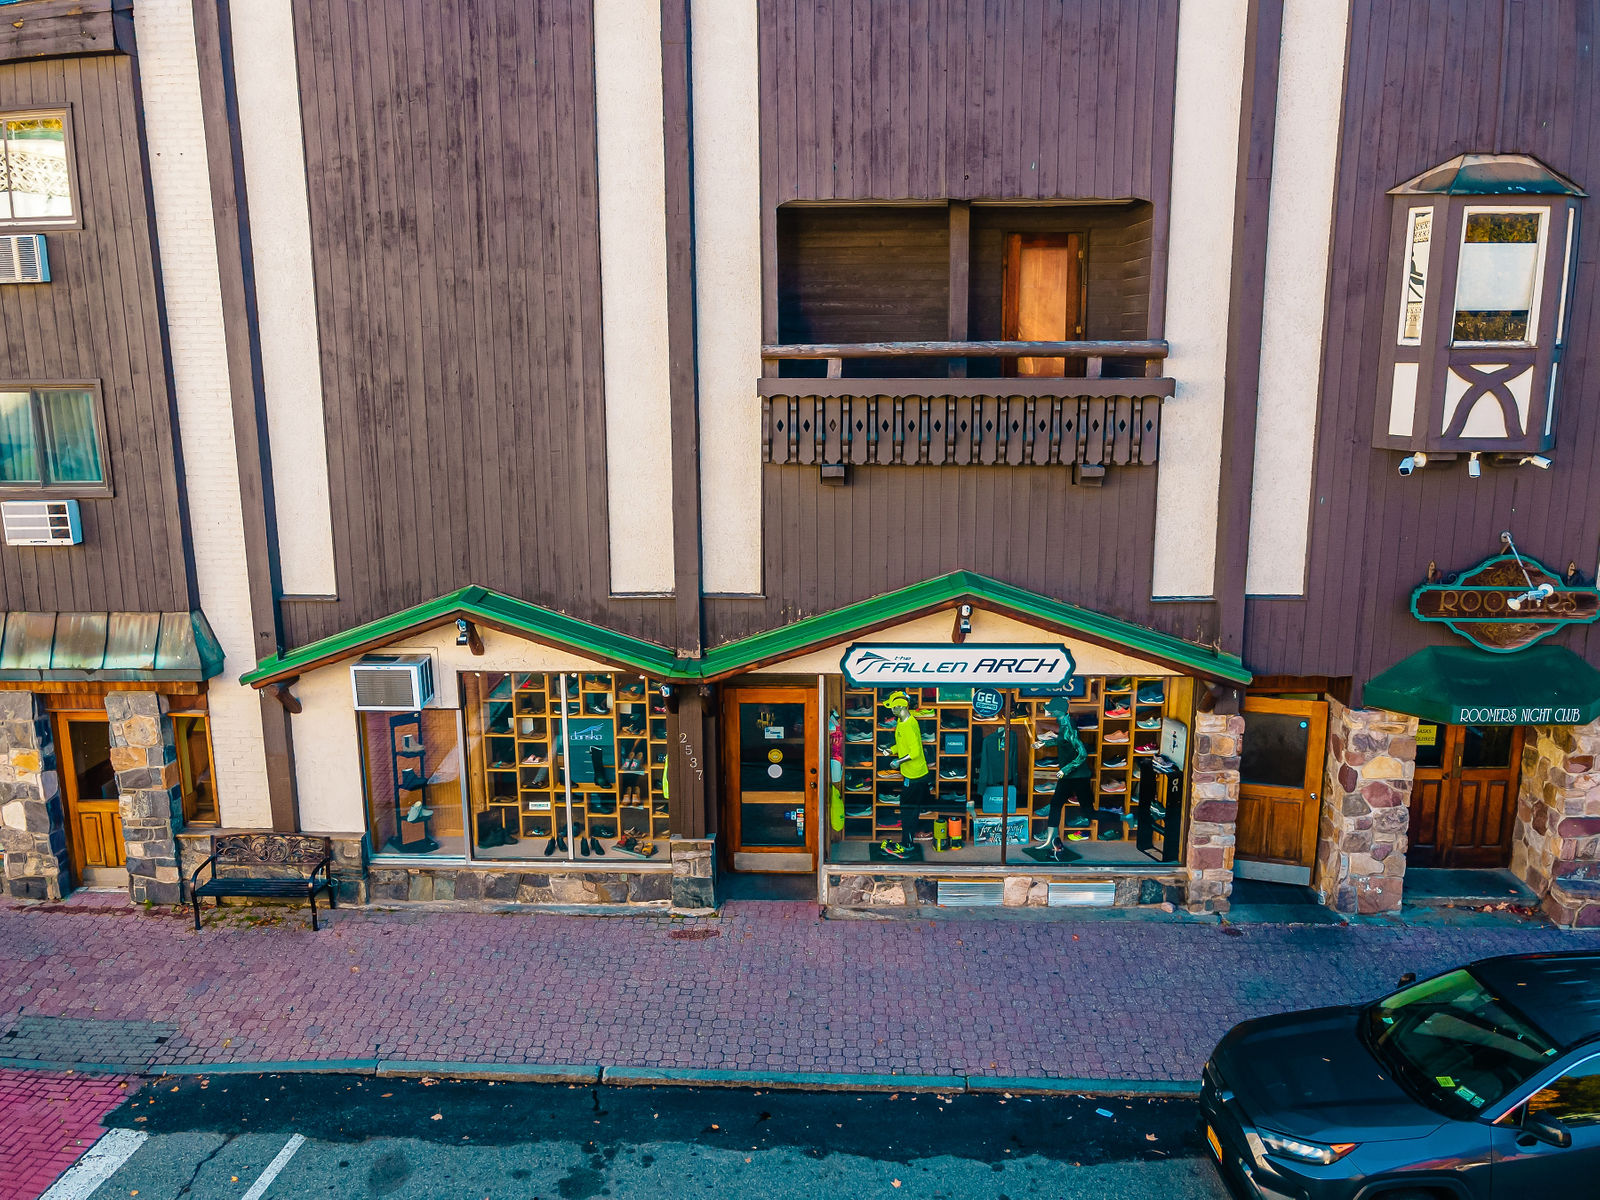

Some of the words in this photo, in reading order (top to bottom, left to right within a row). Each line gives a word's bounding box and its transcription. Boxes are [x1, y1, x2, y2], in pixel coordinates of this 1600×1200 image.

[1438, 590, 1577, 613] ROORS
[877, 661, 969, 673] FALLEN
[972, 658, 1060, 673] ARCH
[977, 691, 999, 705] GEL
[1460, 708, 1517, 723] ROOMERS
[1520, 708, 1552, 722] NIGHT
[1554, 708, 1581, 722] CLUB
[679, 732, 704, 781] 2537
